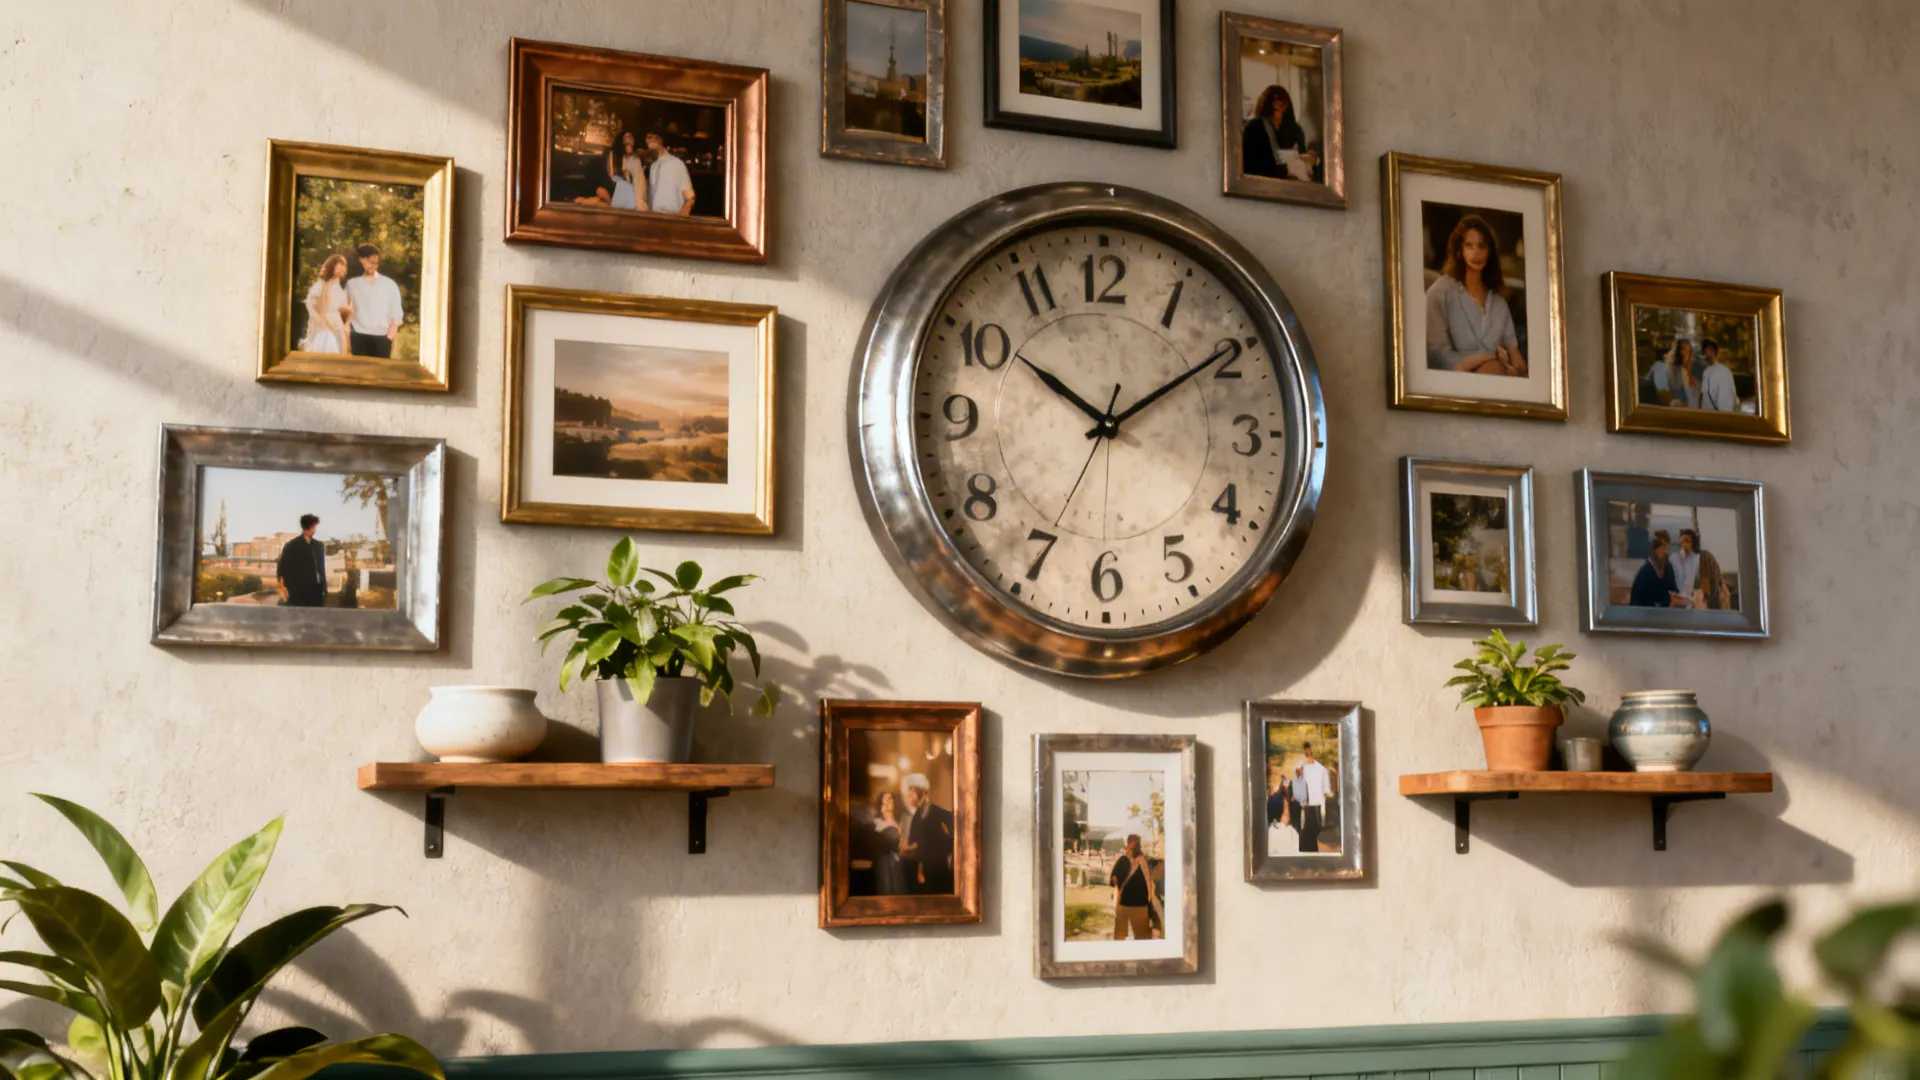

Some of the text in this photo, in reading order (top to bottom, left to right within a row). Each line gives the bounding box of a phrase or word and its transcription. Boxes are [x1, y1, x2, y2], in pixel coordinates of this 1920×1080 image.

[1016, 262, 1058, 317] 11
[1080, 253, 1127, 305] 12
[1161, 280, 1185, 330] 1
[960, 320, 1011, 371] 10
[1213, 337, 1243, 379] 2
[943, 394, 979, 442] 9
[1231, 414, 1262, 457] 3
[964, 472, 998, 521] 8
[1211, 483, 1242, 525] 4
[1026, 528, 1058, 581] 7
[1091, 551, 1123, 603] 6
[1163, 534, 1194, 582] 5
